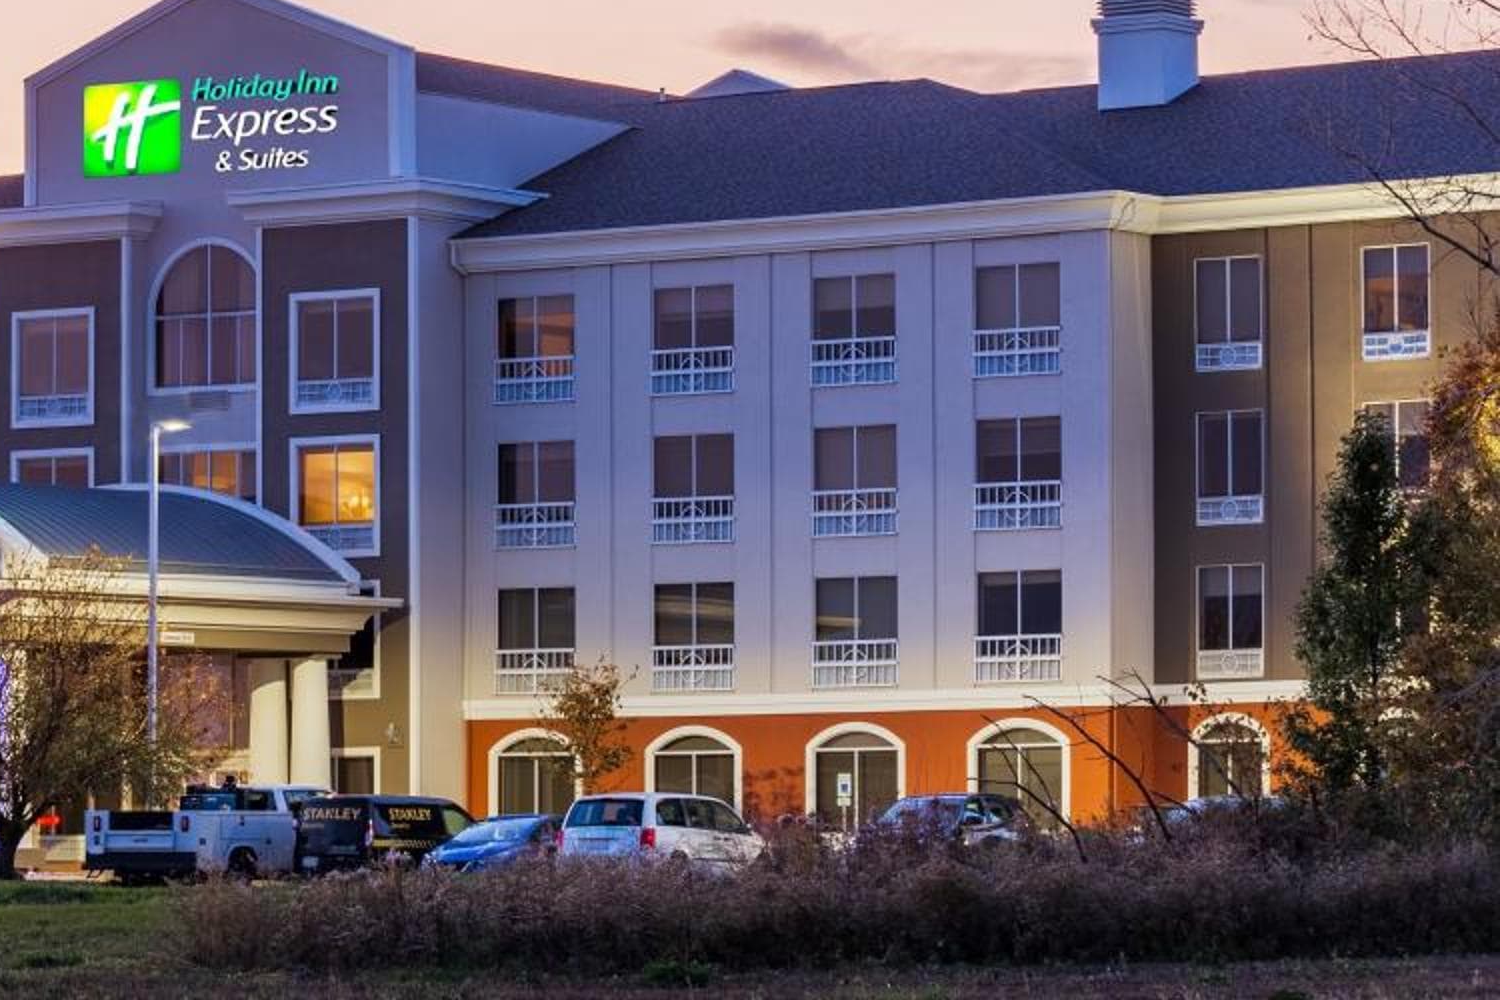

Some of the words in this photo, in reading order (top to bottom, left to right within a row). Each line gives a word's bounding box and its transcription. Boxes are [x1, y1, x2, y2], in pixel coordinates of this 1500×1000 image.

[191, 74, 293, 102] Holiday
[297, 68, 339, 94] Inn
[190, 104, 339, 147] Express
[215, 150, 232, 173] &
[238, 147, 309, 171] Suites
[303, 807, 361, 821] STANLEY
[388, 807, 431, 821] STANLEY
